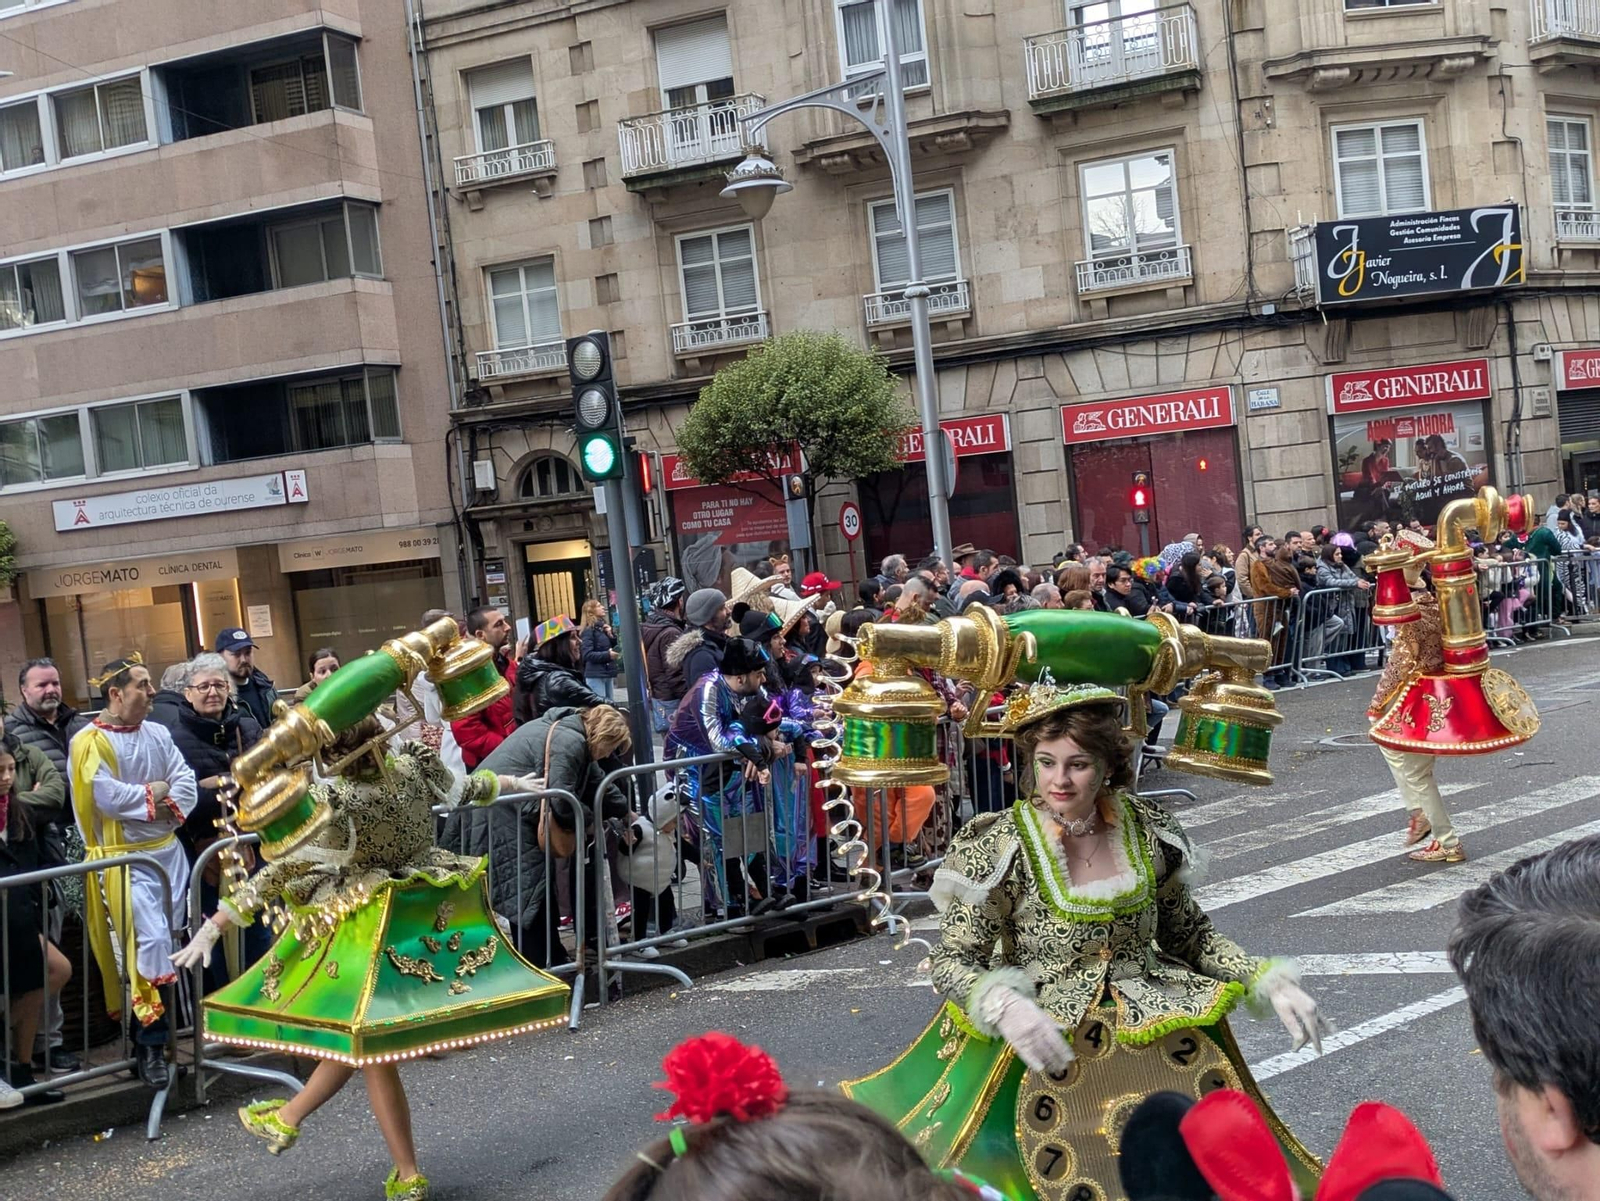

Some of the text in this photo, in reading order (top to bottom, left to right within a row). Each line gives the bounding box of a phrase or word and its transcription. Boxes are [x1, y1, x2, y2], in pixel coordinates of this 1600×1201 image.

[1390, 215, 1460, 227] Administración Fincas
[1390, 224, 1461, 236] Gestión Comunidades
[1433, 234, 1461, 242] Empresa
[1371, 270, 1427, 290] Nogueira,
[1373, 368, 1484, 400] GENERALI
[1107, 397, 1222, 430] GENERALI
[1418, 412, 1455, 436] AHORA
[1433, 475, 1442, 486] SE
[1434, 488, 1440, 496] Y
[1442, 481, 1465, 494] AHORA
[136, 484, 218, 505] colexio oficial da
[701, 497, 754, 509] PARA TI NO HAY
[99, 492, 256, 521] arquitectura técnica de ourense
[693, 508, 734, 520] OTRO LUGAR
[682, 517, 732, 530] COMO TU CASA
[845, 514, 858, 528] 30
[398, 540, 412, 549] 988
[412, 539, 422, 547] 00
[422, 538, 432, 546] 39
[54, 560, 223, 588] JORGEMATO CLÍNICA DENTAL
[1084, 1021, 1103, 1048] 4
[1171, 1037, 1197, 1065] 2
[1034, 1095, 1055, 1121] 6
[1042, 1147, 1063, 1175] 7
